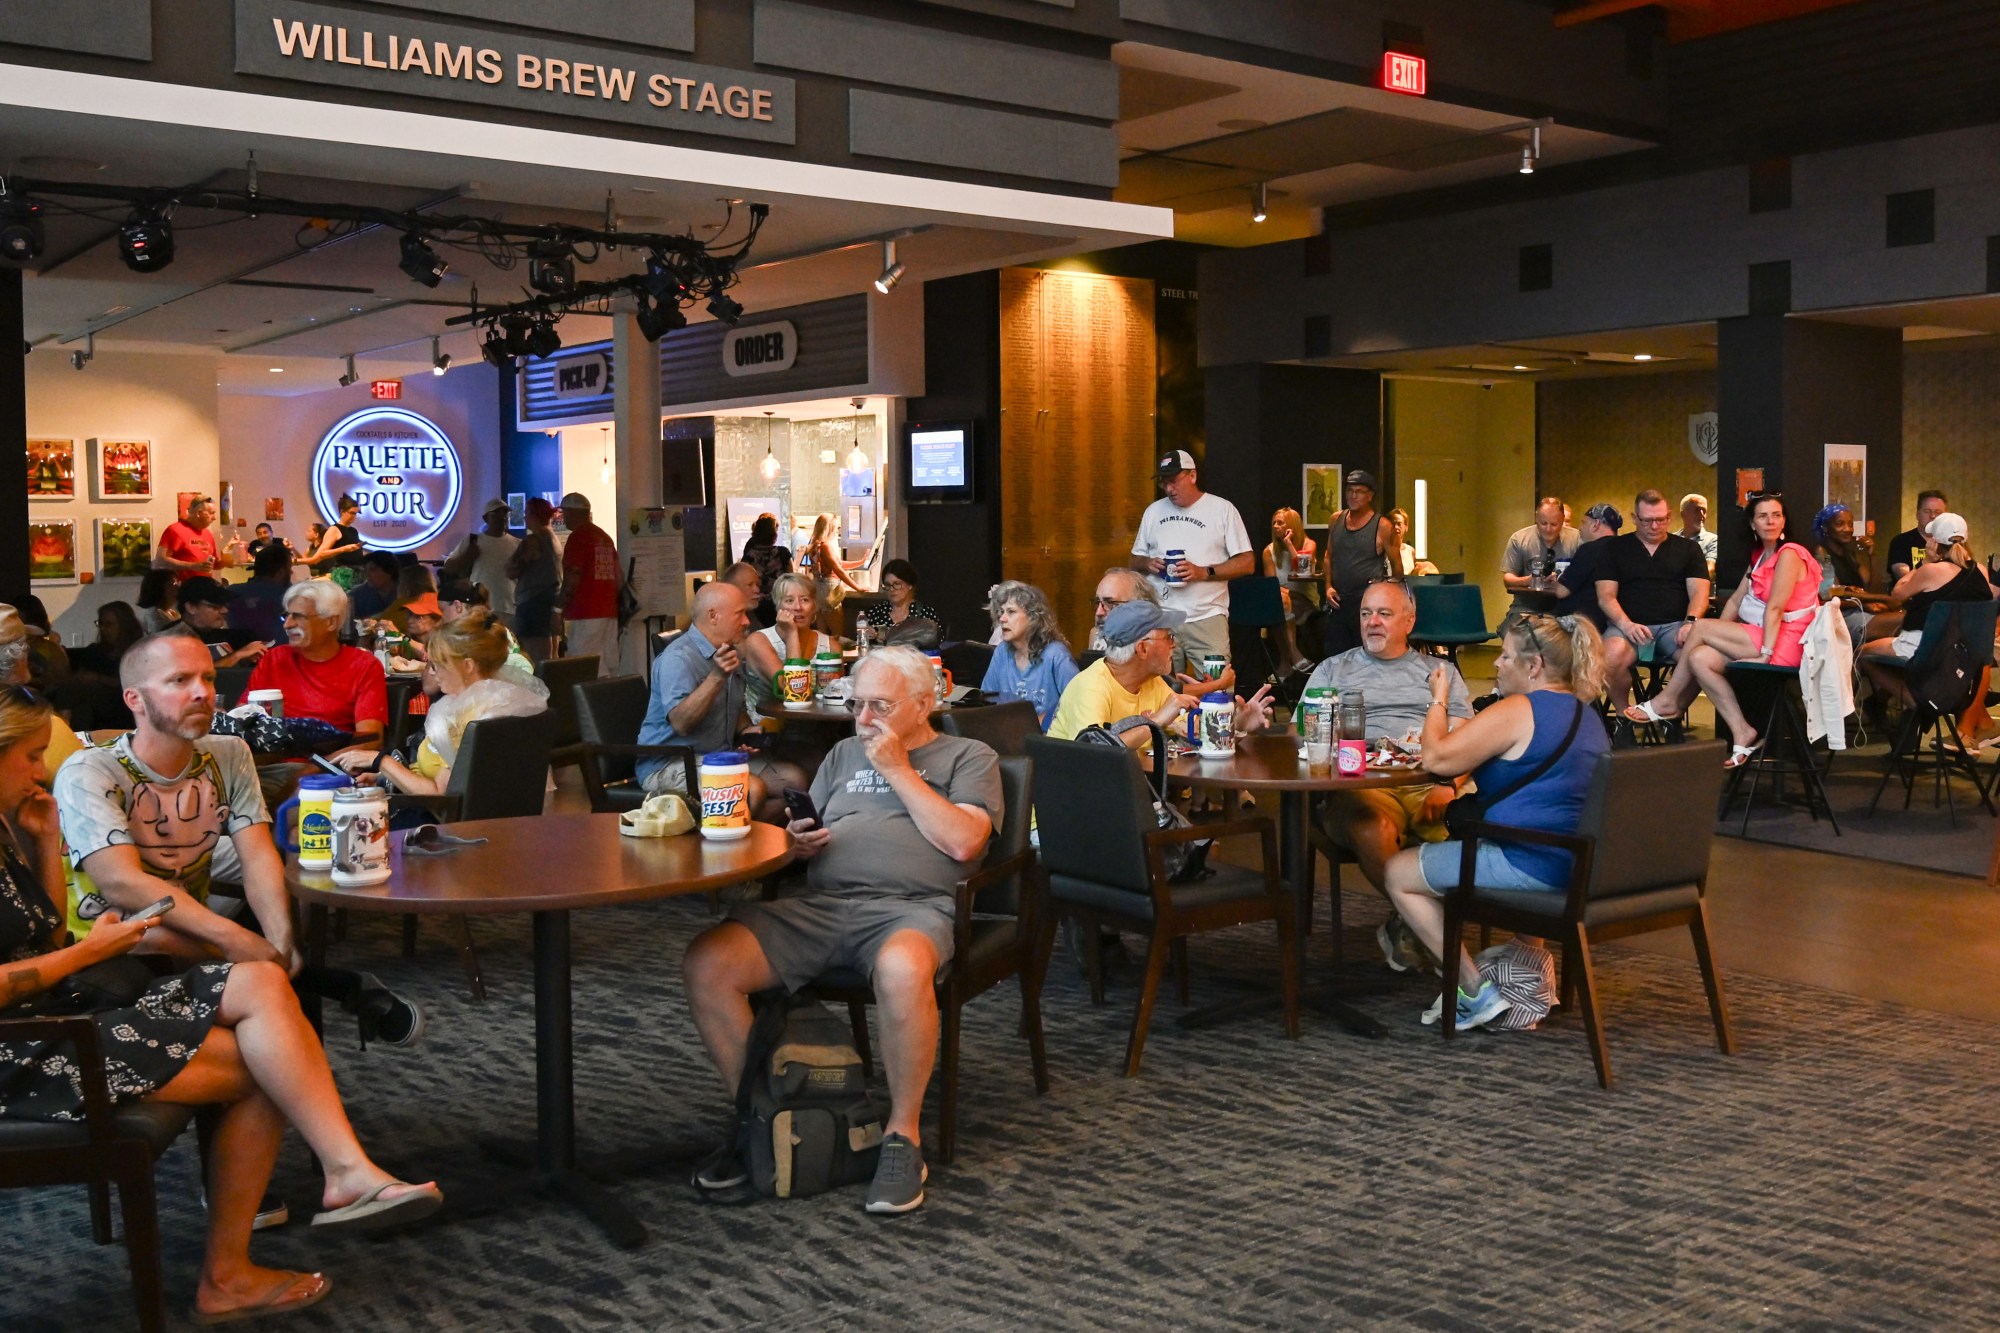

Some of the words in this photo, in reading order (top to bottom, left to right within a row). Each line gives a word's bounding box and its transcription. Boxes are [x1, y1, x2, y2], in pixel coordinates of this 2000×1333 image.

[273, 18, 502, 84] WILLIAMS
[517, 53, 636, 102] BREW
[647, 73, 774, 122] STAGE
[1392, 56, 1419, 90] EXIT
[1161, 288, 1185, 299] STEEL
[734, 332, 784, 366] ORDER
[559, 363, 600, 391] PICK-UP
[377, 382, 398, 398] EXIT
[356, 430, 387, 438] COCKTAILS
[394, 431, 419, 439] KITCHEN
[333, 445, 446, 474] PALETTE
[381, 477, 400, 485] AND
[355, 491, 435, 520] POUR
[846, 777, 872, 788] WANTED
[876, 777, 884, 785] TO
[855, 769, 875, 779] WHEN
[702, 784, 744, 802] MUSIK
[703, 800, 735, 817] FEST
